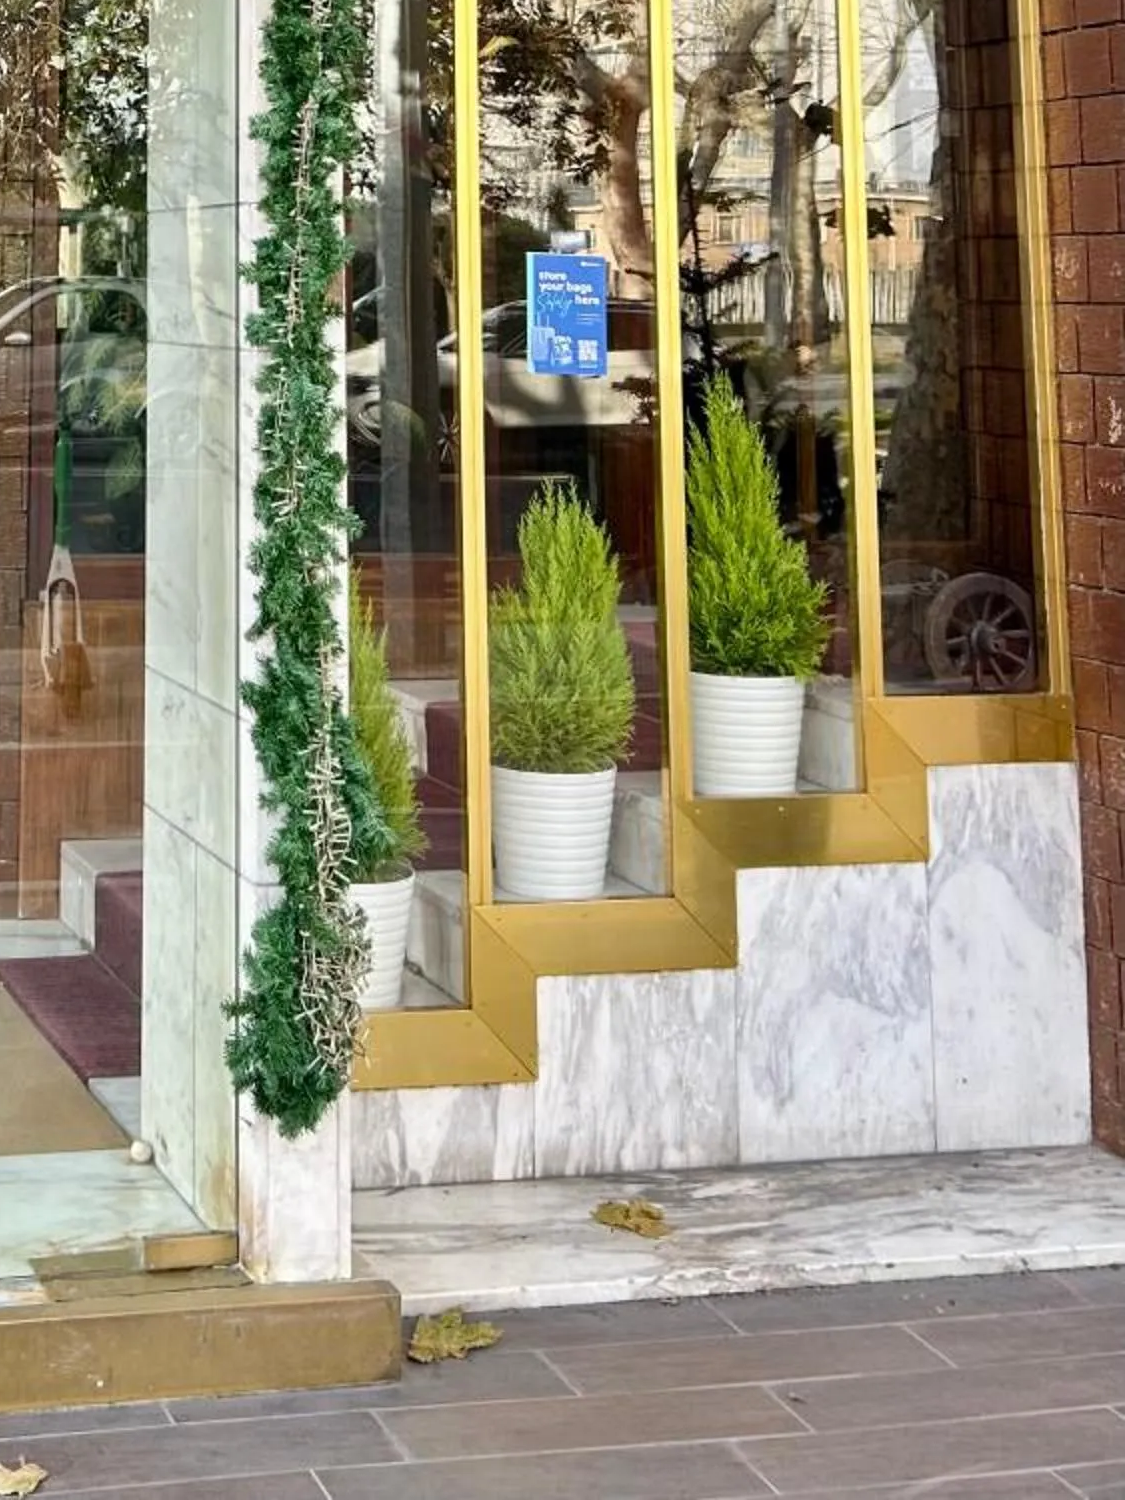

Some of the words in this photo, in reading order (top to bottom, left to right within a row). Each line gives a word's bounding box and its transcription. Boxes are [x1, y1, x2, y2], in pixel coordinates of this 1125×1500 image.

[538, 282, 566, 293] your
[566, 282, 593, 294] bags
[574, 295, 600, 305] here
